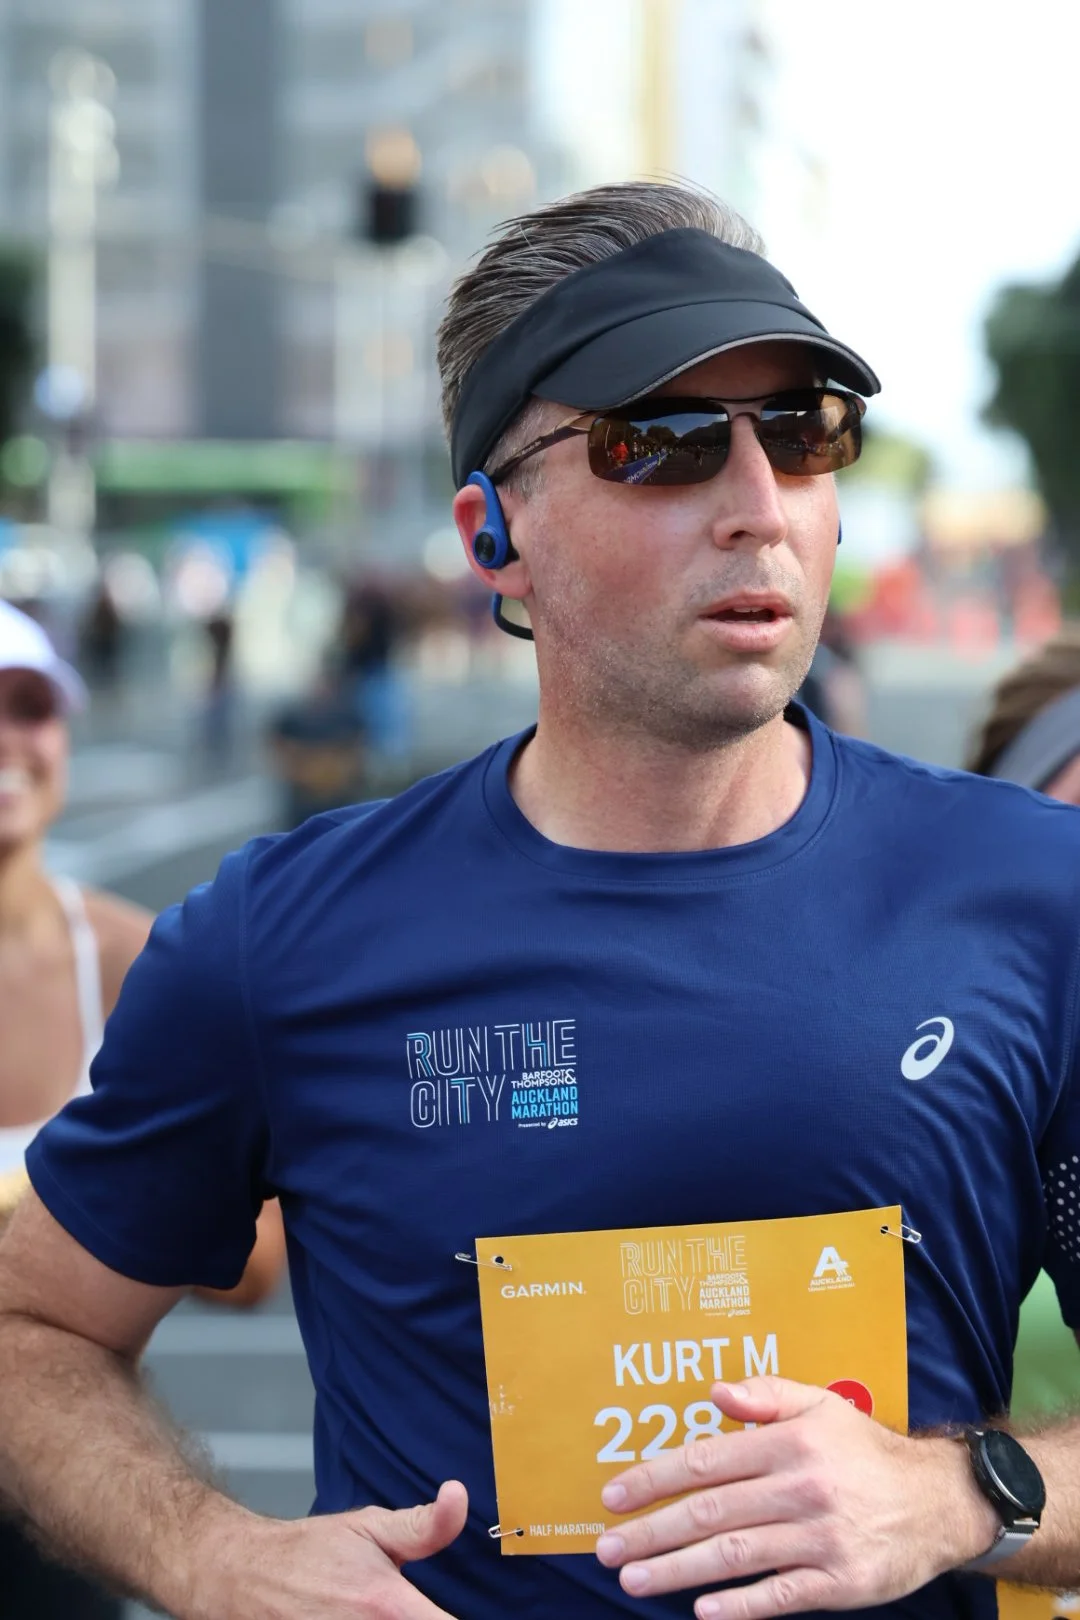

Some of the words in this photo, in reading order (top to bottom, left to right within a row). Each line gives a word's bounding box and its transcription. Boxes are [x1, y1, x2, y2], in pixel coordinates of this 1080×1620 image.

[406, 1026, 490, 1079] RUN
[494, 1019, 577, 1071] THE
[511, 1078, 565, 1089] THOMPSON
[411, 1074, 506, 1128] CITY
[511, 1086, 578, 1105] AUCKLAND
[511, 1101, 578, 1120] MARATHON
[619, 1239, 682, 1278] RUN
[685, 1235, 748, 1273] THE
[623, 1275, 695, 1315] CITY
[699, 1285, 750, 1298] AUCKLAND
[699, 1296, 751, 1310] MARATHON
[613, 1337, 730, 1387] KURT
[742, 1333, 779, 1377] M
[530, 1524, 553, 1536] HALF
[554, 1522, 605, 1536] MARATHON
